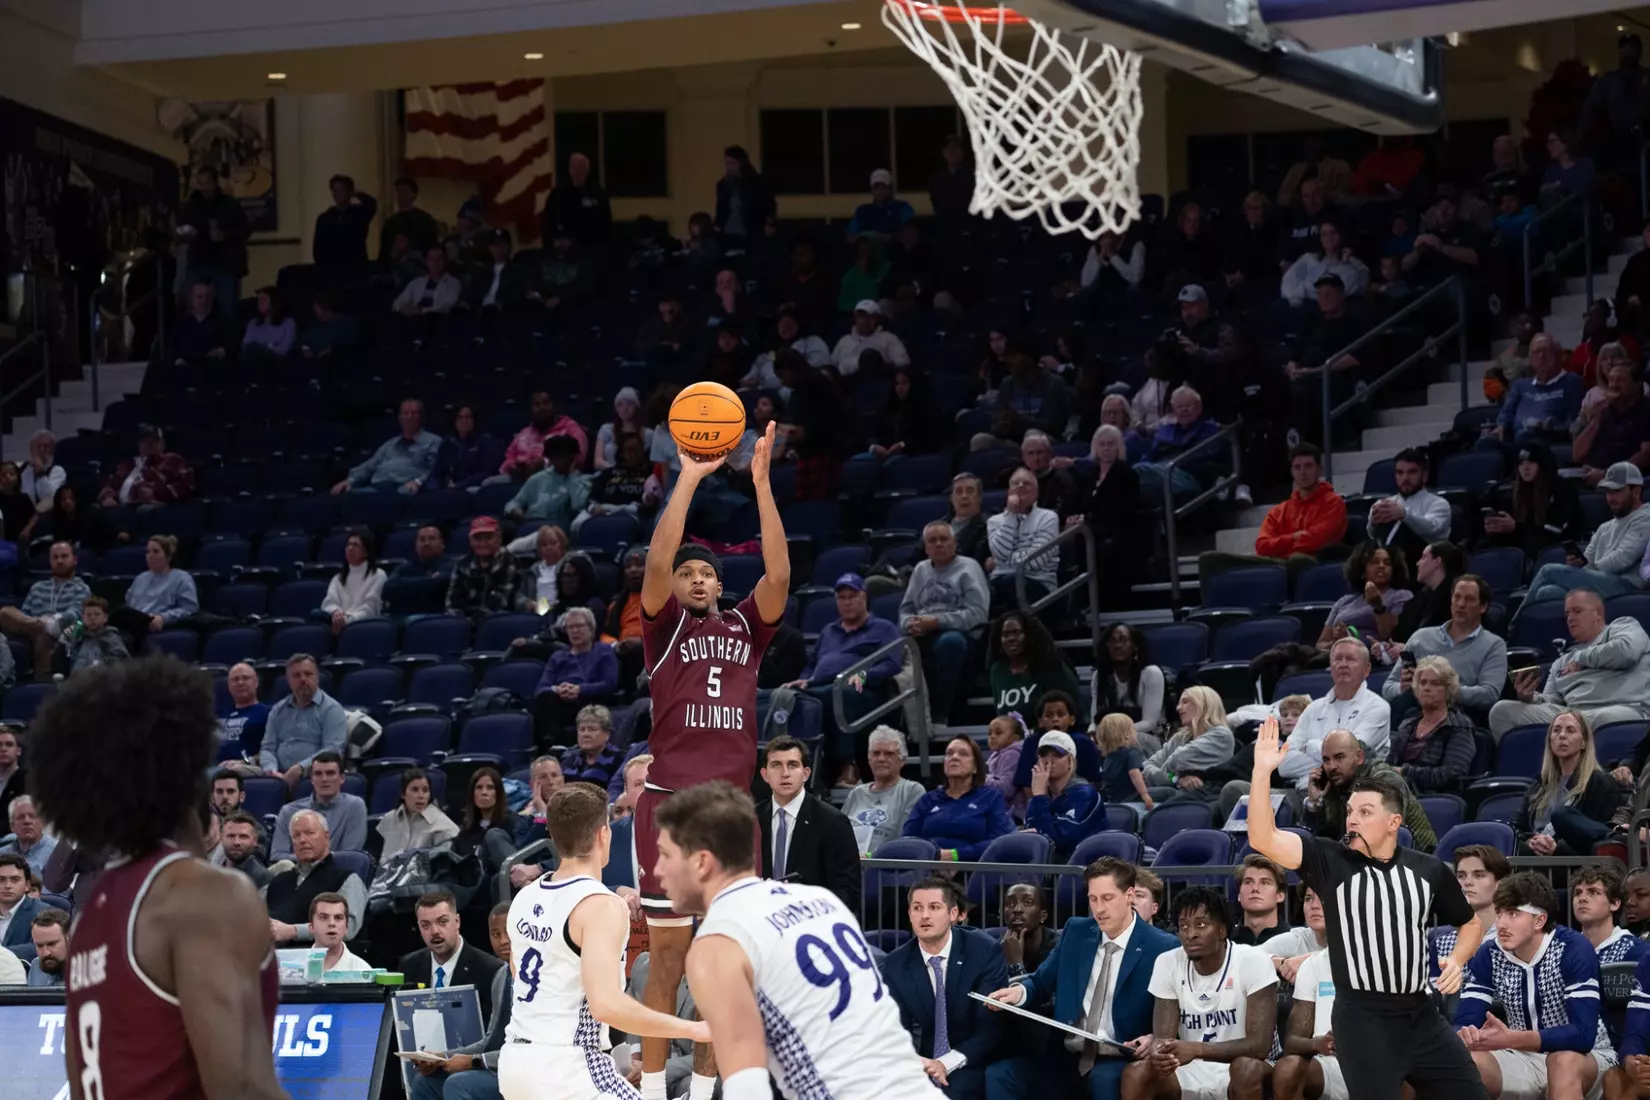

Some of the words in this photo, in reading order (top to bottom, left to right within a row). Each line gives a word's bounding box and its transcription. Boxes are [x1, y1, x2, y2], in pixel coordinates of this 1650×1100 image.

[689, 431, 720, 441] EVO
[680, 635, 751, 666] SOUTHERN
[707, 666, 722, 698] 5
[997, 683, 1037, 709] JOY
[685, 704, 743, 730] ILLINOIS
[517, 947, 543, 1003] 9
[796, 922, 883, 1022] 99
[79, 1001, 105, 1100] 8
